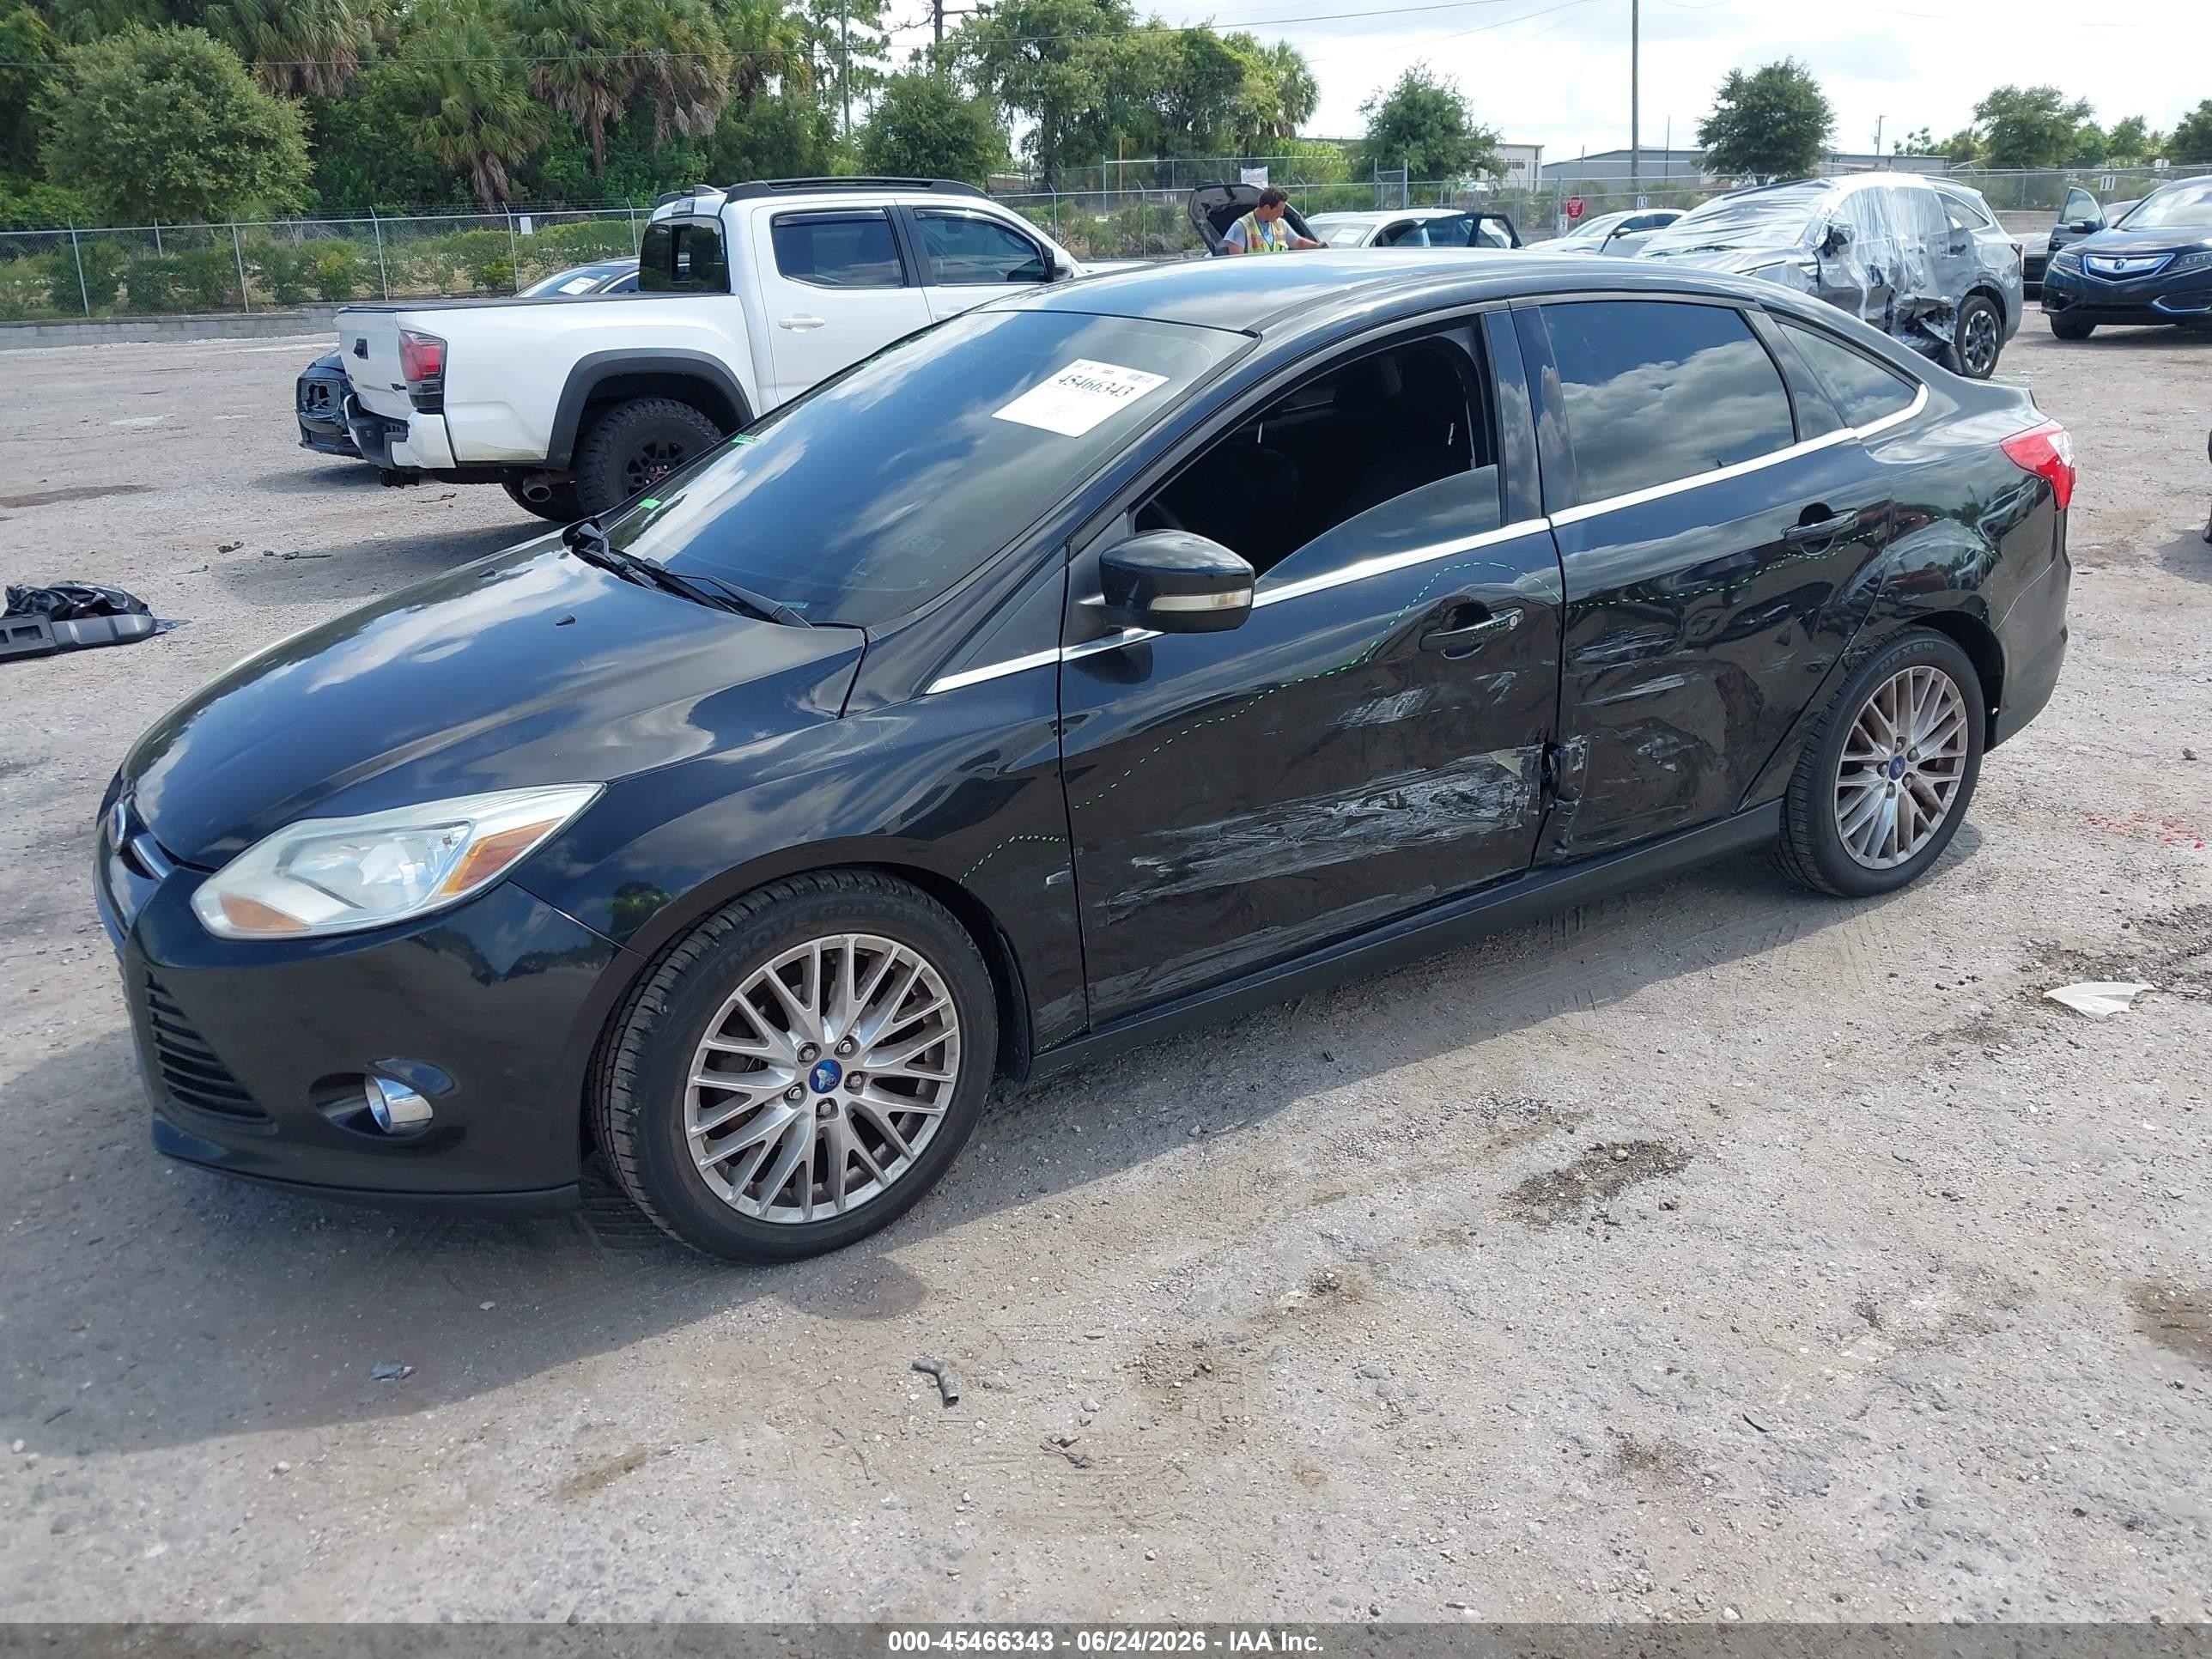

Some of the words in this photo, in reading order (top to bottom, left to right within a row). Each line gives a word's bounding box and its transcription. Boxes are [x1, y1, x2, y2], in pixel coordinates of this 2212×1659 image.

[2102, 177, 2113, 190] 11
[1638, 198, 1646, 208] 13
[1058, 374, 1135, 398] 45466343
[1879, 641, 1936, 673] NEXEN
